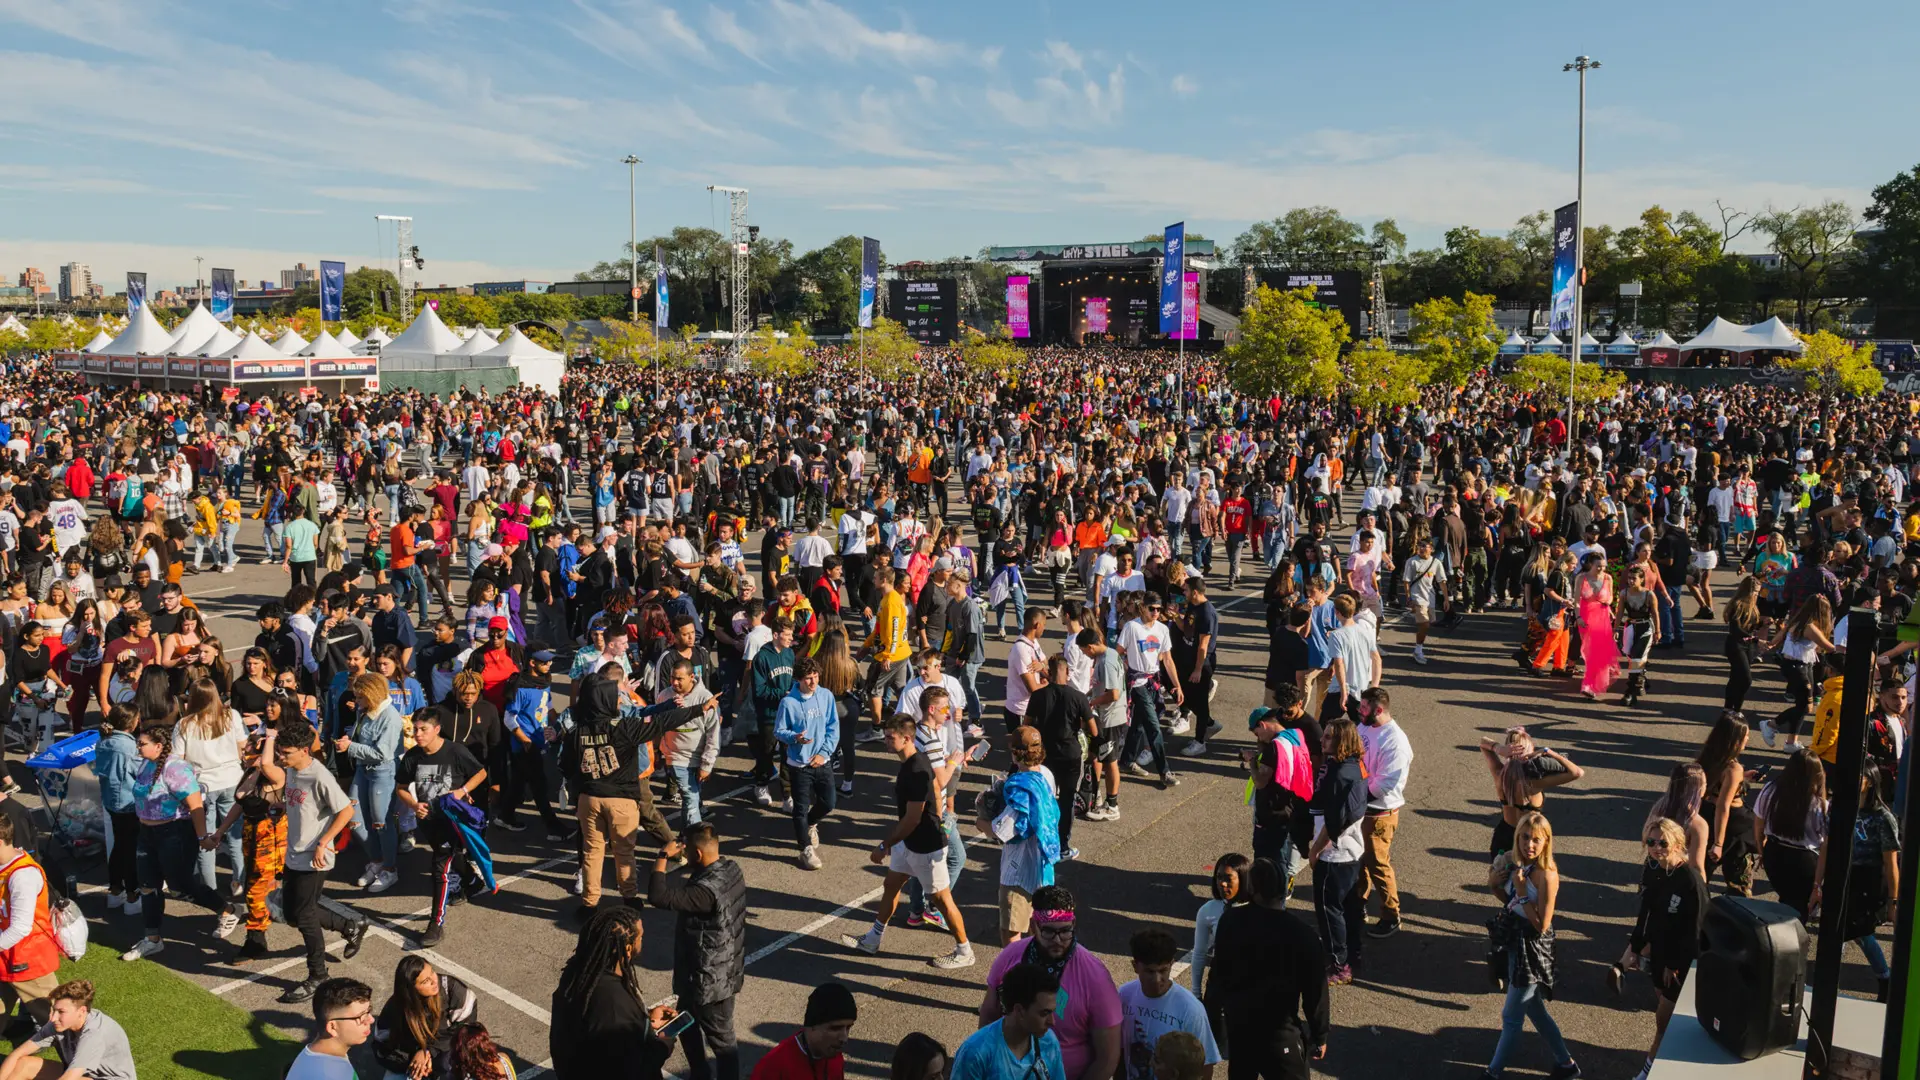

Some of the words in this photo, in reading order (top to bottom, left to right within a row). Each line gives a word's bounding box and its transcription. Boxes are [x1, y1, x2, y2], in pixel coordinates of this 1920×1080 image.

[1084, 245, 1128, 258] STAGE
[1008, 284, 1028, 293] MERCH
[1008, 314, 1028, 323] MERCH
[271, 365, 296, 373] WATER
[319, 363, 336, 371] BEER
[57, 514, 76, 529] 48
[580, 745, 620, 779] 40
[1137, 1006, 1184, 1030] YACHTY
